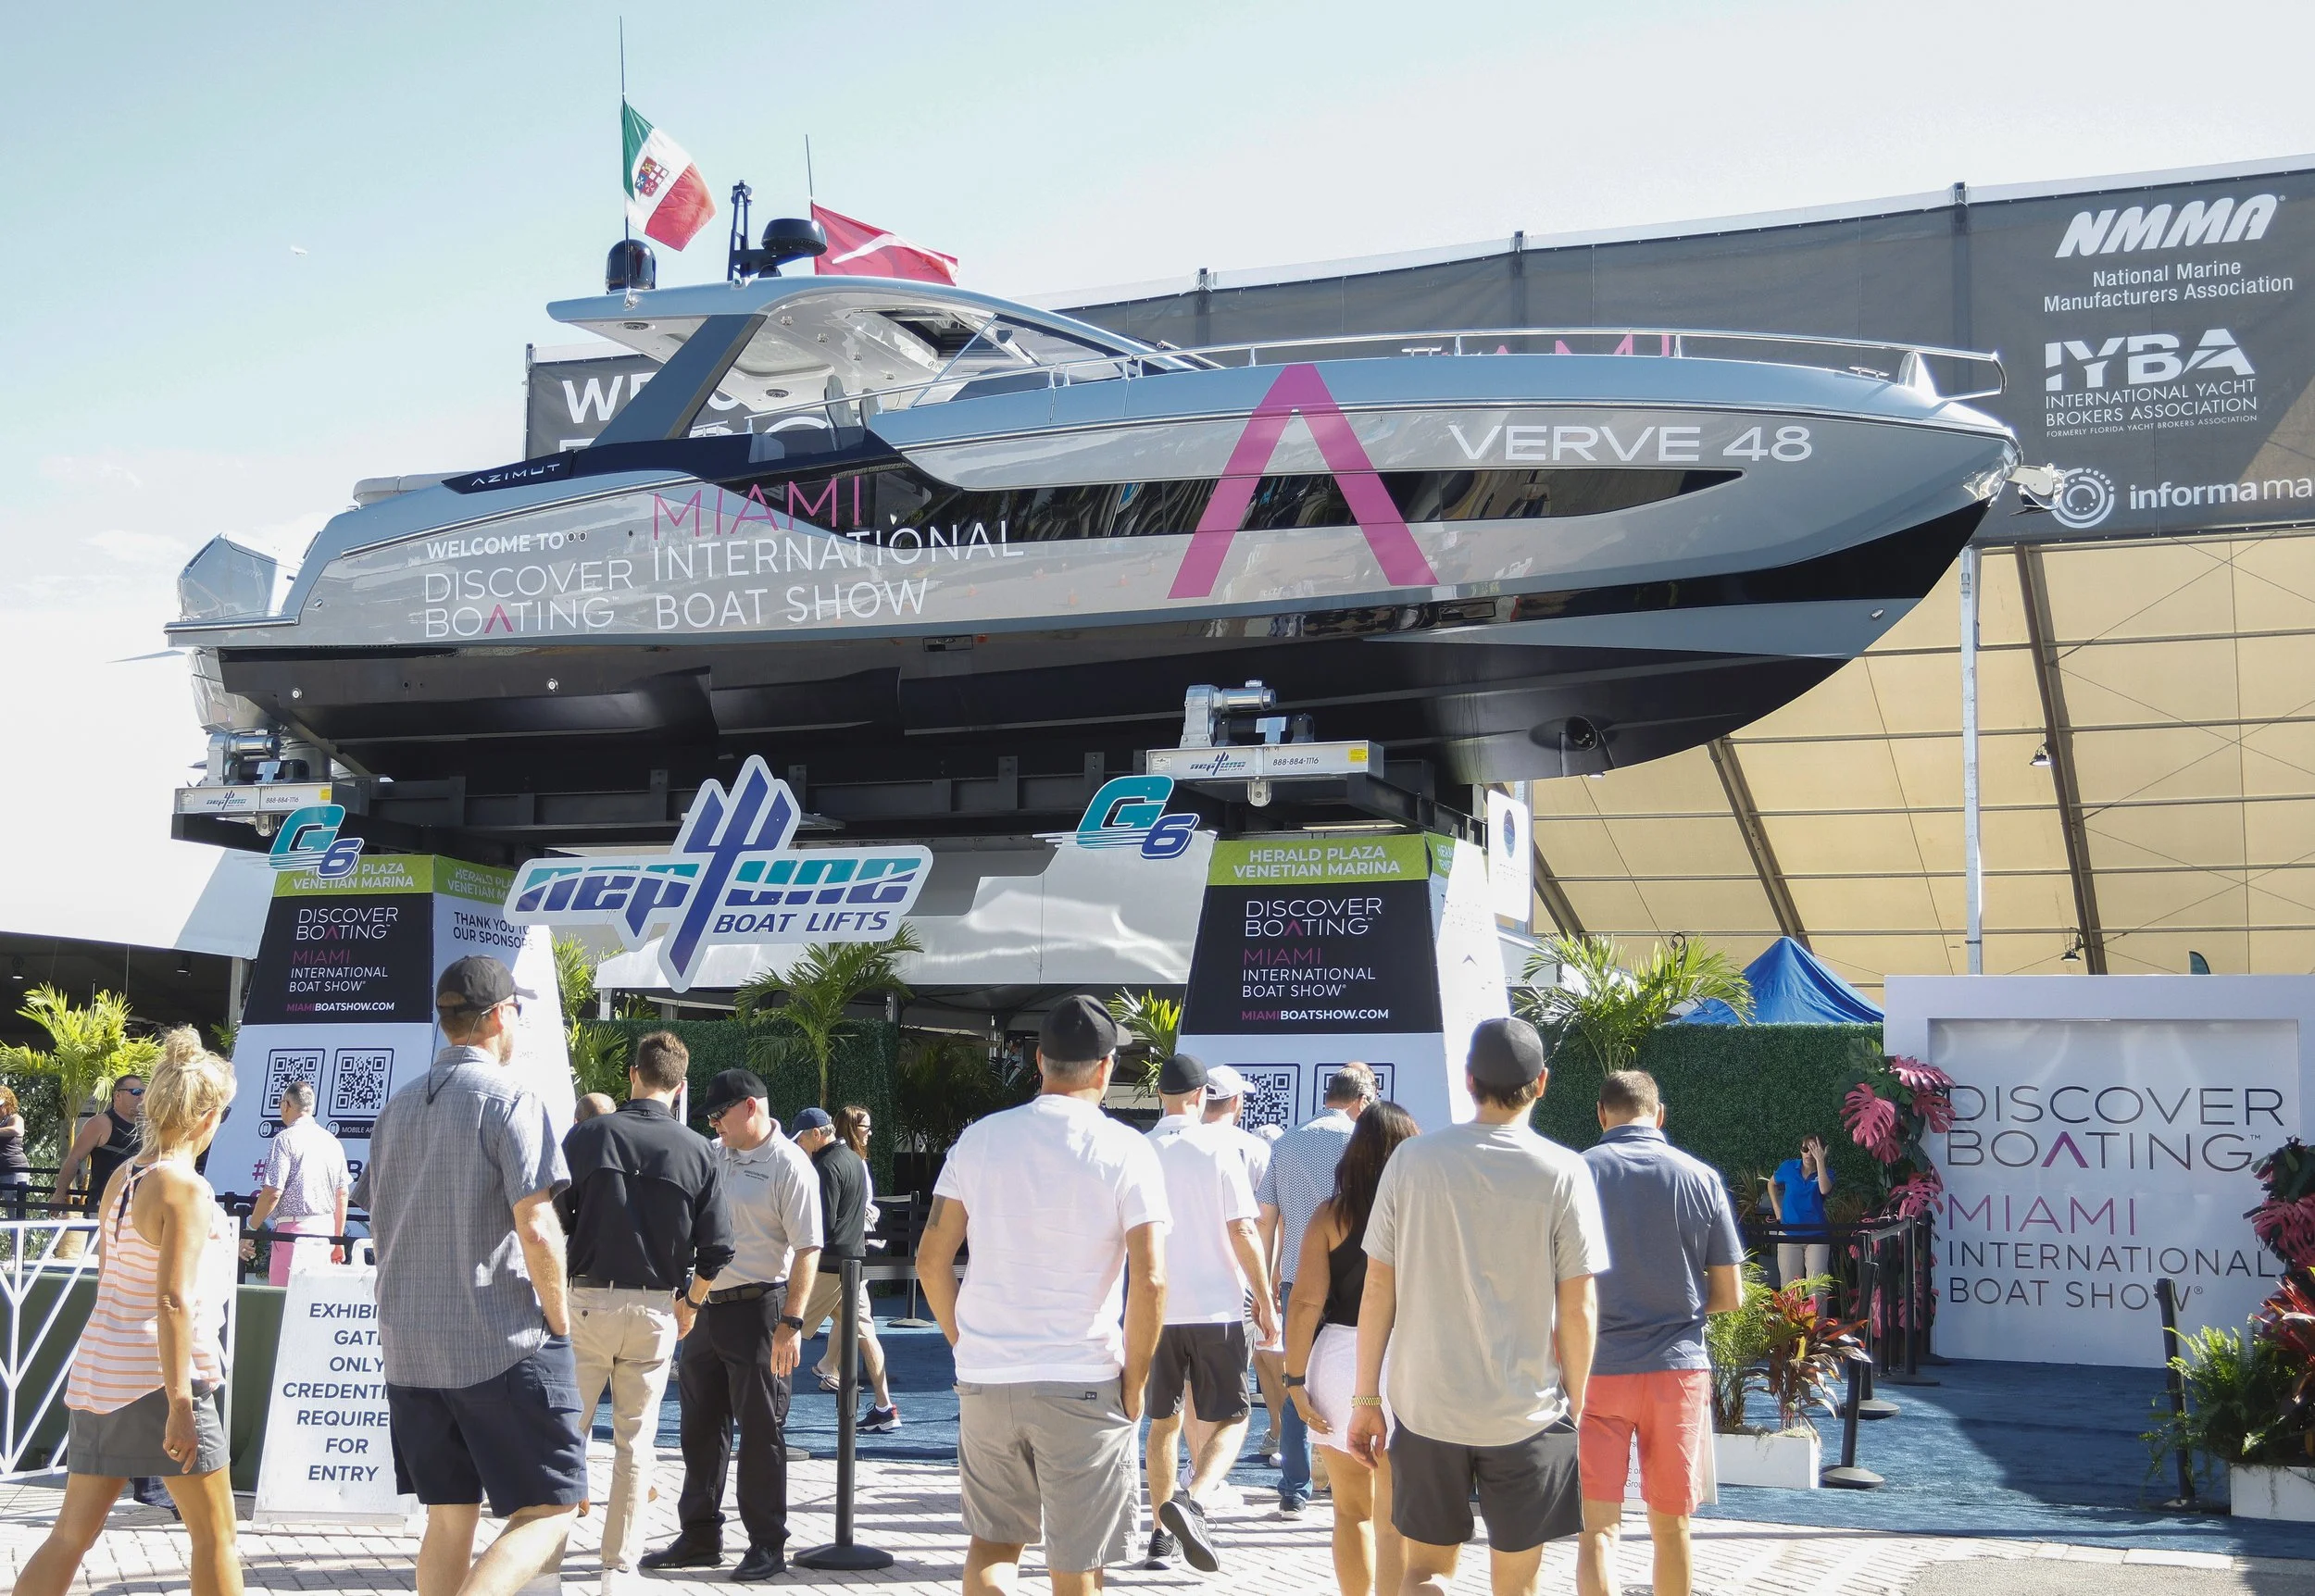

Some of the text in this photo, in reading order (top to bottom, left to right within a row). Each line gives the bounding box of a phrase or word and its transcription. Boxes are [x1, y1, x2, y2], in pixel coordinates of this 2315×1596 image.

[2055, 194, 2278, 258] NMMA
[2093, 260, 2242, 288] National Marine
[2044, 275, 2294, 313] Manufacturers Association
[2045, 328, 2256, 393] IYBA
[2045, 379, 2257, 409] INTERNATIONAL YACHT
[2046, 396, 2258, 427] BROKERS ASSOCIATION
[2046, 415, 2258, 438] FORMERLY FLORIDA YACHT BROKERS ASSOCIATION
[1448, 425, 1813, 462] VERVE 48
[471, 463, 560, 487] AZIMUT
[2130, 477, 2315, 510] informa ma
[654, 475, 860, 541] MIAMI
[426, 531, 565, 560] WELCOME TO
[654, 520, 1024, 582] INTERNATIONAL
[425, 558, 633, 604] DISCOVER
[656, 578, 928, 630] BOAT SHOW
[1271, 756, 1320, 767] 888-884-1116
[1250, 845, 1386, 863] HERALD PLAZA
[362, 863, 405, 875] PLAZA
[1233, 860, 1401, 879] VENETIAN MARINA
[294, 875, 415, 890] VENETIAN MARINA
[447, 879, 495, 899] VENETIAN
[298, 907, 399, 924] DISCOVER
[1245, 897, 1383, 917] DISCOVER
[454, 911, 492, 929] THANK
[493, 917, 515, 934] YOU
[711, 911, 890, 934] BOAT LIFTS
[453, 927, 477, 942] OUR
[293, 949, 351, 965] MIAMI
[1244, 947, 1321, 966] MIAMI
[290, 966, 389, 979] INTERNATIONAL
[1243, 967, 1376, 981] INTERNATIONAL
[289, 981, 321, 992] BOAT
[1242, 985, 1285, 998] BOAT
[286, 1002, 395, 1012] MIAMIBOATSHOW.COM
[1241, 1009, 1389, 1021] MIAMIBOATSHOW.COM
[1948, 1085, 2284, 1127] DISCOVER
[1948, 1193, 2135, 1236] MIAMI
[1948, 1241, 2277, 1278] INTERNATIONAL
[1950, 1277, 2049, 1307] BOAT
[329, 1356, 385, 1372] ONLY
[325, 1438, 369, 1454] FOR
[307, 1465, 380, 1482] ENTRY
